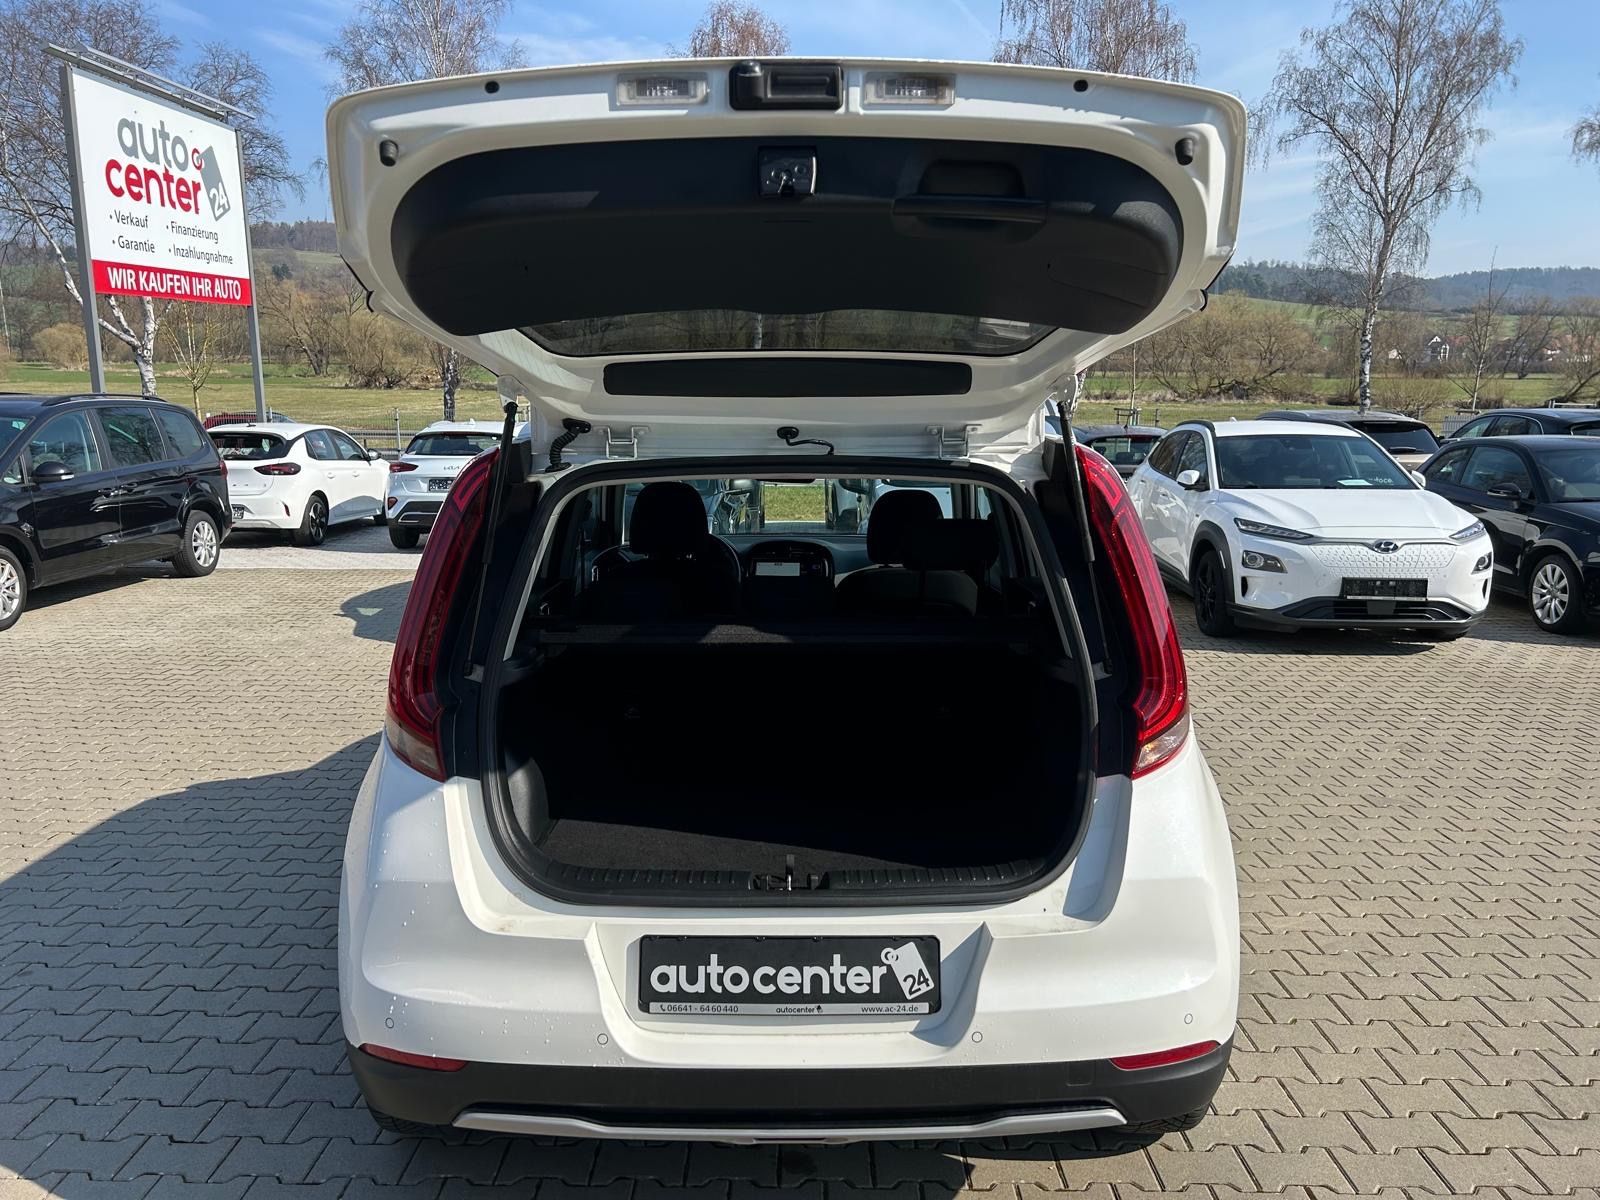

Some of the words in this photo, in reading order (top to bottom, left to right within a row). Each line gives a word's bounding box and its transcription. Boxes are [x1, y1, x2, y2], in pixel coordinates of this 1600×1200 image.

[117, 117, 189, 172] auto
[105, 159, 201, 215] center
[209, 183, 228, 214] 24
[114, 210, 149, 228] Verkauf
[118, 235, 155, 253] Garantie
[170, 221, 219, 244] Finanzierung
[173, 244, 233, 264] Inzahlungnahme
[107, 267, 137, 290] WIR
[139, 270, 191, 295] KAUFEN
[192, 276, 213, 297] IHR
[214, 278, 242, 300] AUTO
[650, 953, 887, 994] autocenter
[902, 968, 931, 996] 24
[667, 1004, 692, 1012] 06641
[776, 1006, 815, 1014] autocenter
[861, 1005, 919, 1013] www.ac-24.de
